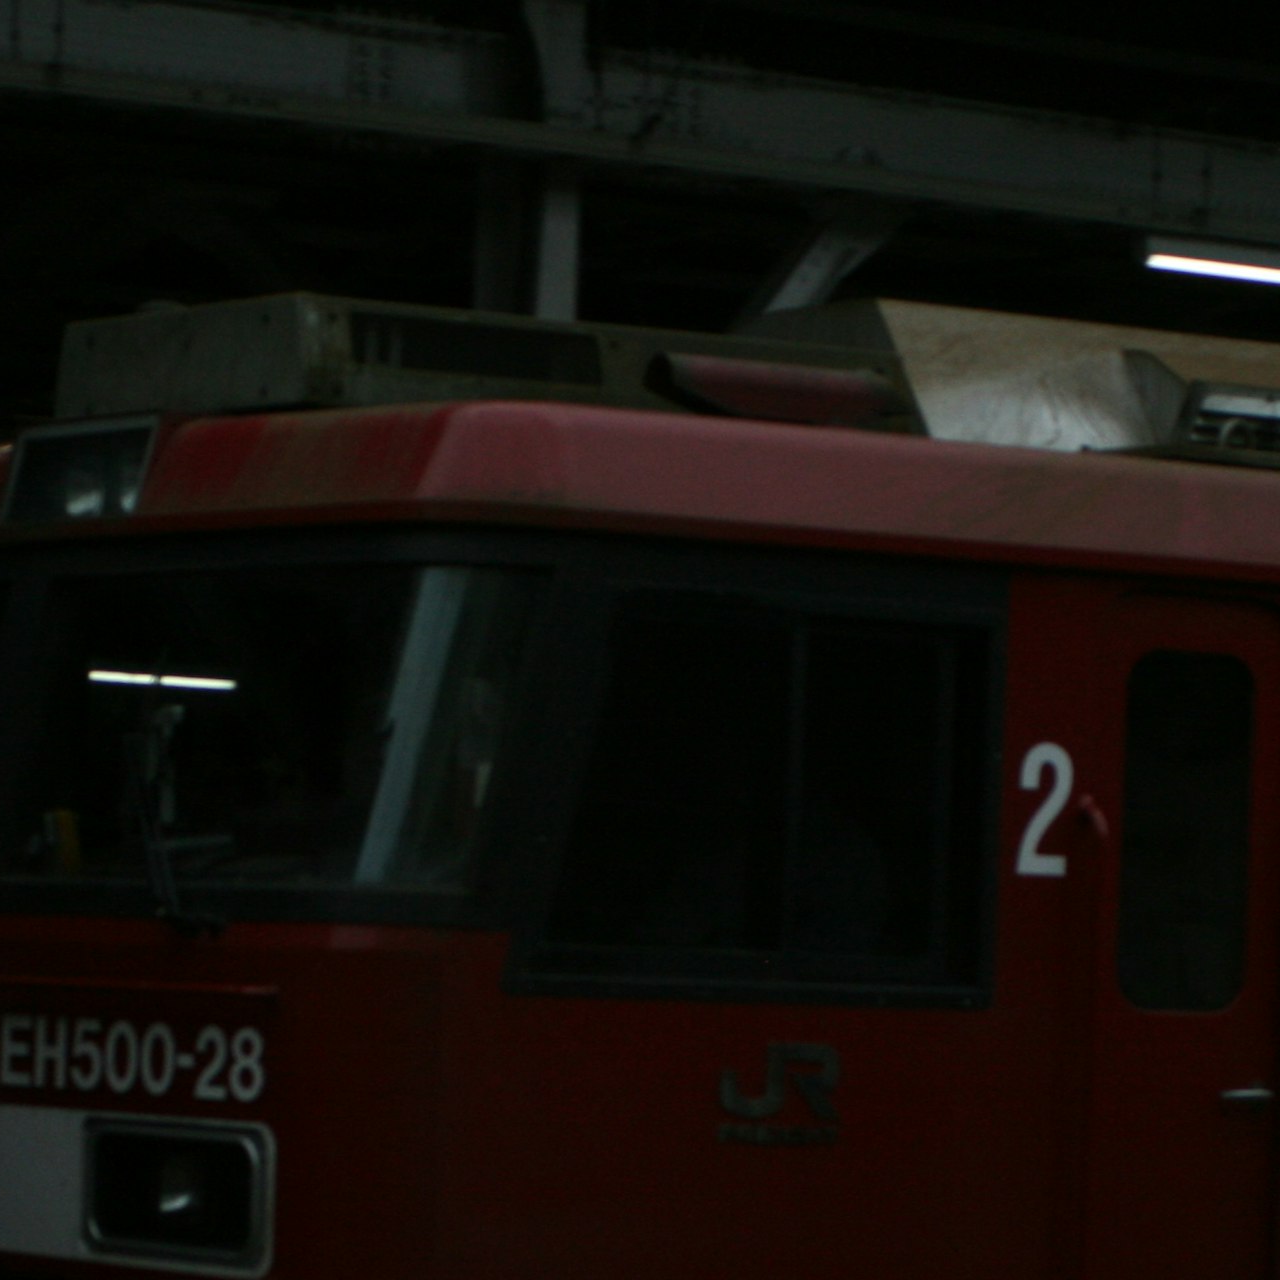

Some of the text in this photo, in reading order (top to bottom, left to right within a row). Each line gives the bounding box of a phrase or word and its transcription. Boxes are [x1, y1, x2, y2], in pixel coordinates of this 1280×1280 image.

[1016, 742, 1073, 876] 2
[0, 1015, 265, 1103] EH500-28
[720, 1042, 840, 1119] JR
